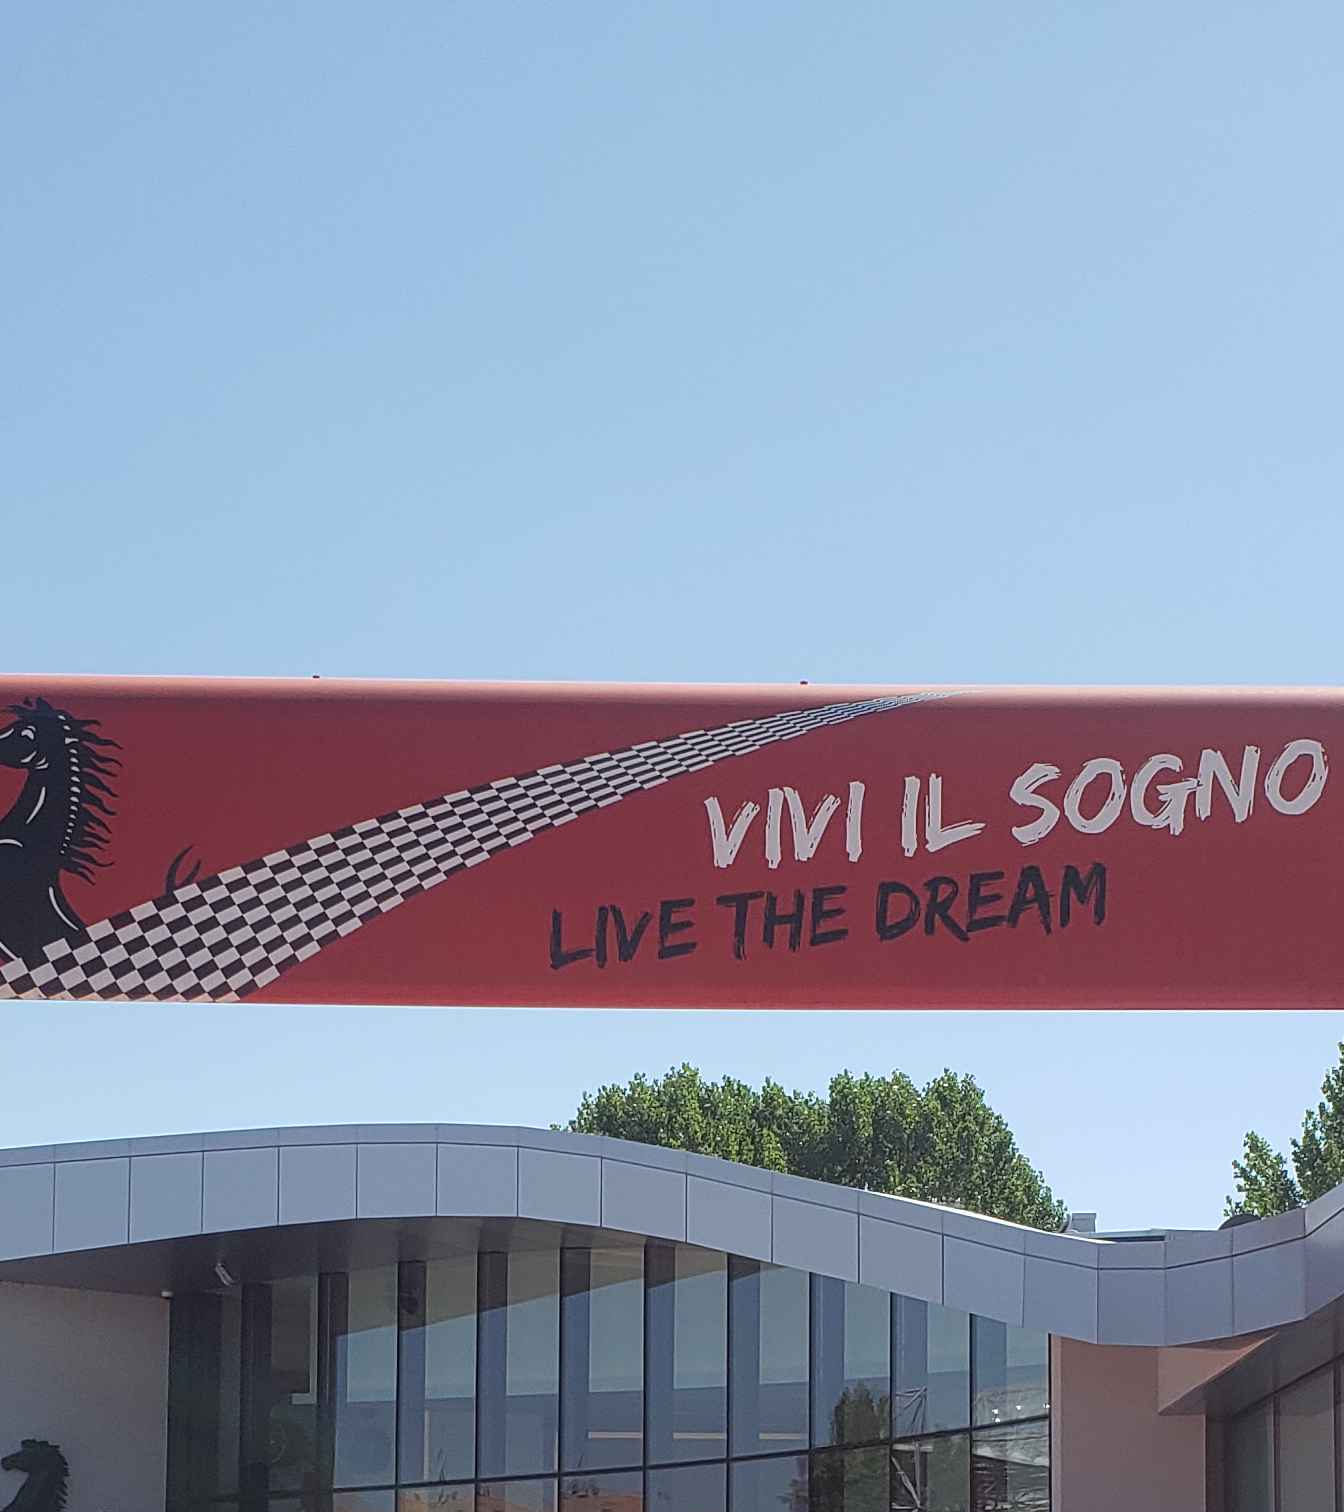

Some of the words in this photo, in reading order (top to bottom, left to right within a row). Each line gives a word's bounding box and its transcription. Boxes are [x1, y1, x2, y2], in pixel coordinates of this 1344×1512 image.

[704, 781, 866, 868] VIVI
[901, 773, 983, 857] IL
[1010, 739, 1329, 846] SOGNO
[549, 897, 697, 969] LIVE
[716, 883, 849, 961] THE
[875, 862, 1107, 943] DREAM
